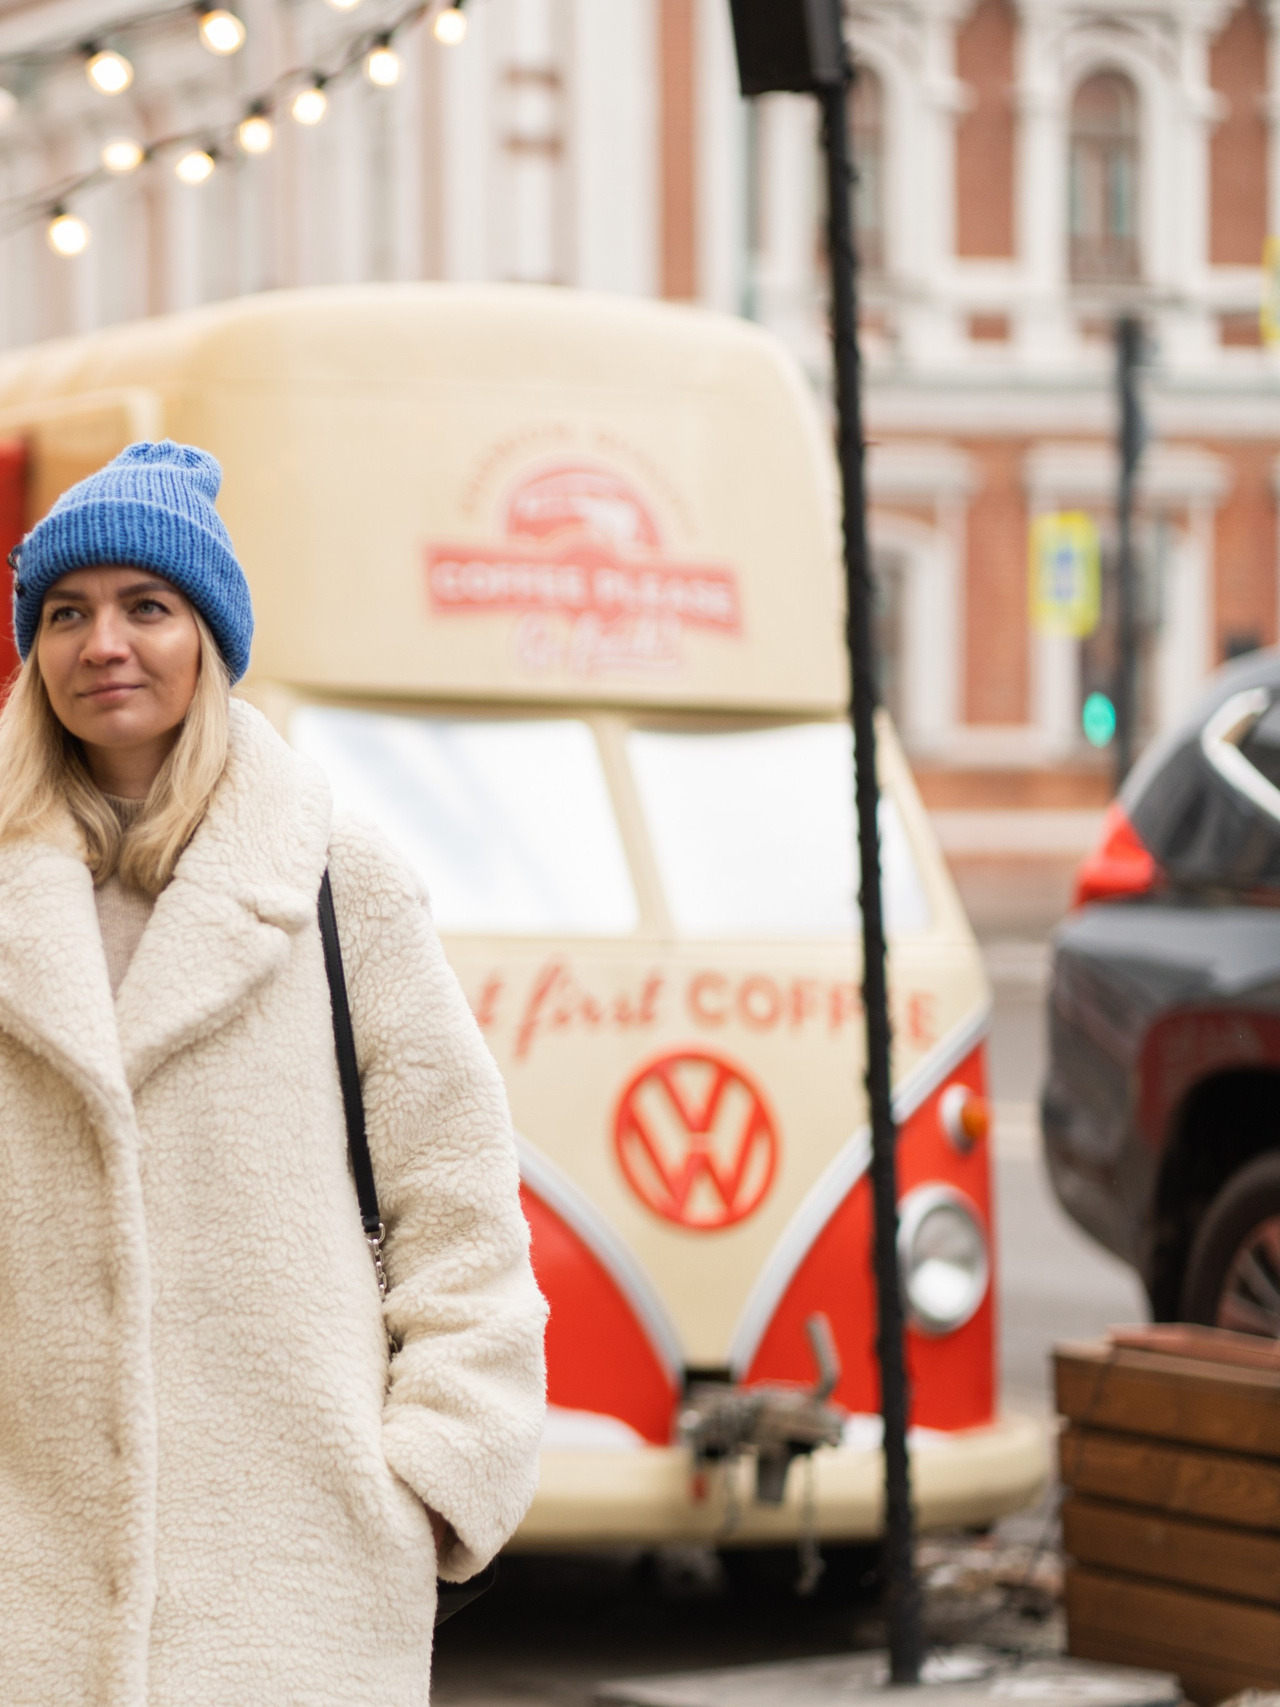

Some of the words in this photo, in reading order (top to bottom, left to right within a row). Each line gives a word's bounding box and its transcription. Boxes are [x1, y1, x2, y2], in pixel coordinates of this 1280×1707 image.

[430, 560, 584, 607] COFFEE
[592, 566, 735, 622] PLEASE
[513, 955, 664, 1063] first
[686, 971, 937, 1048] COFFE
[614, 1047, 776, 1230] VW
